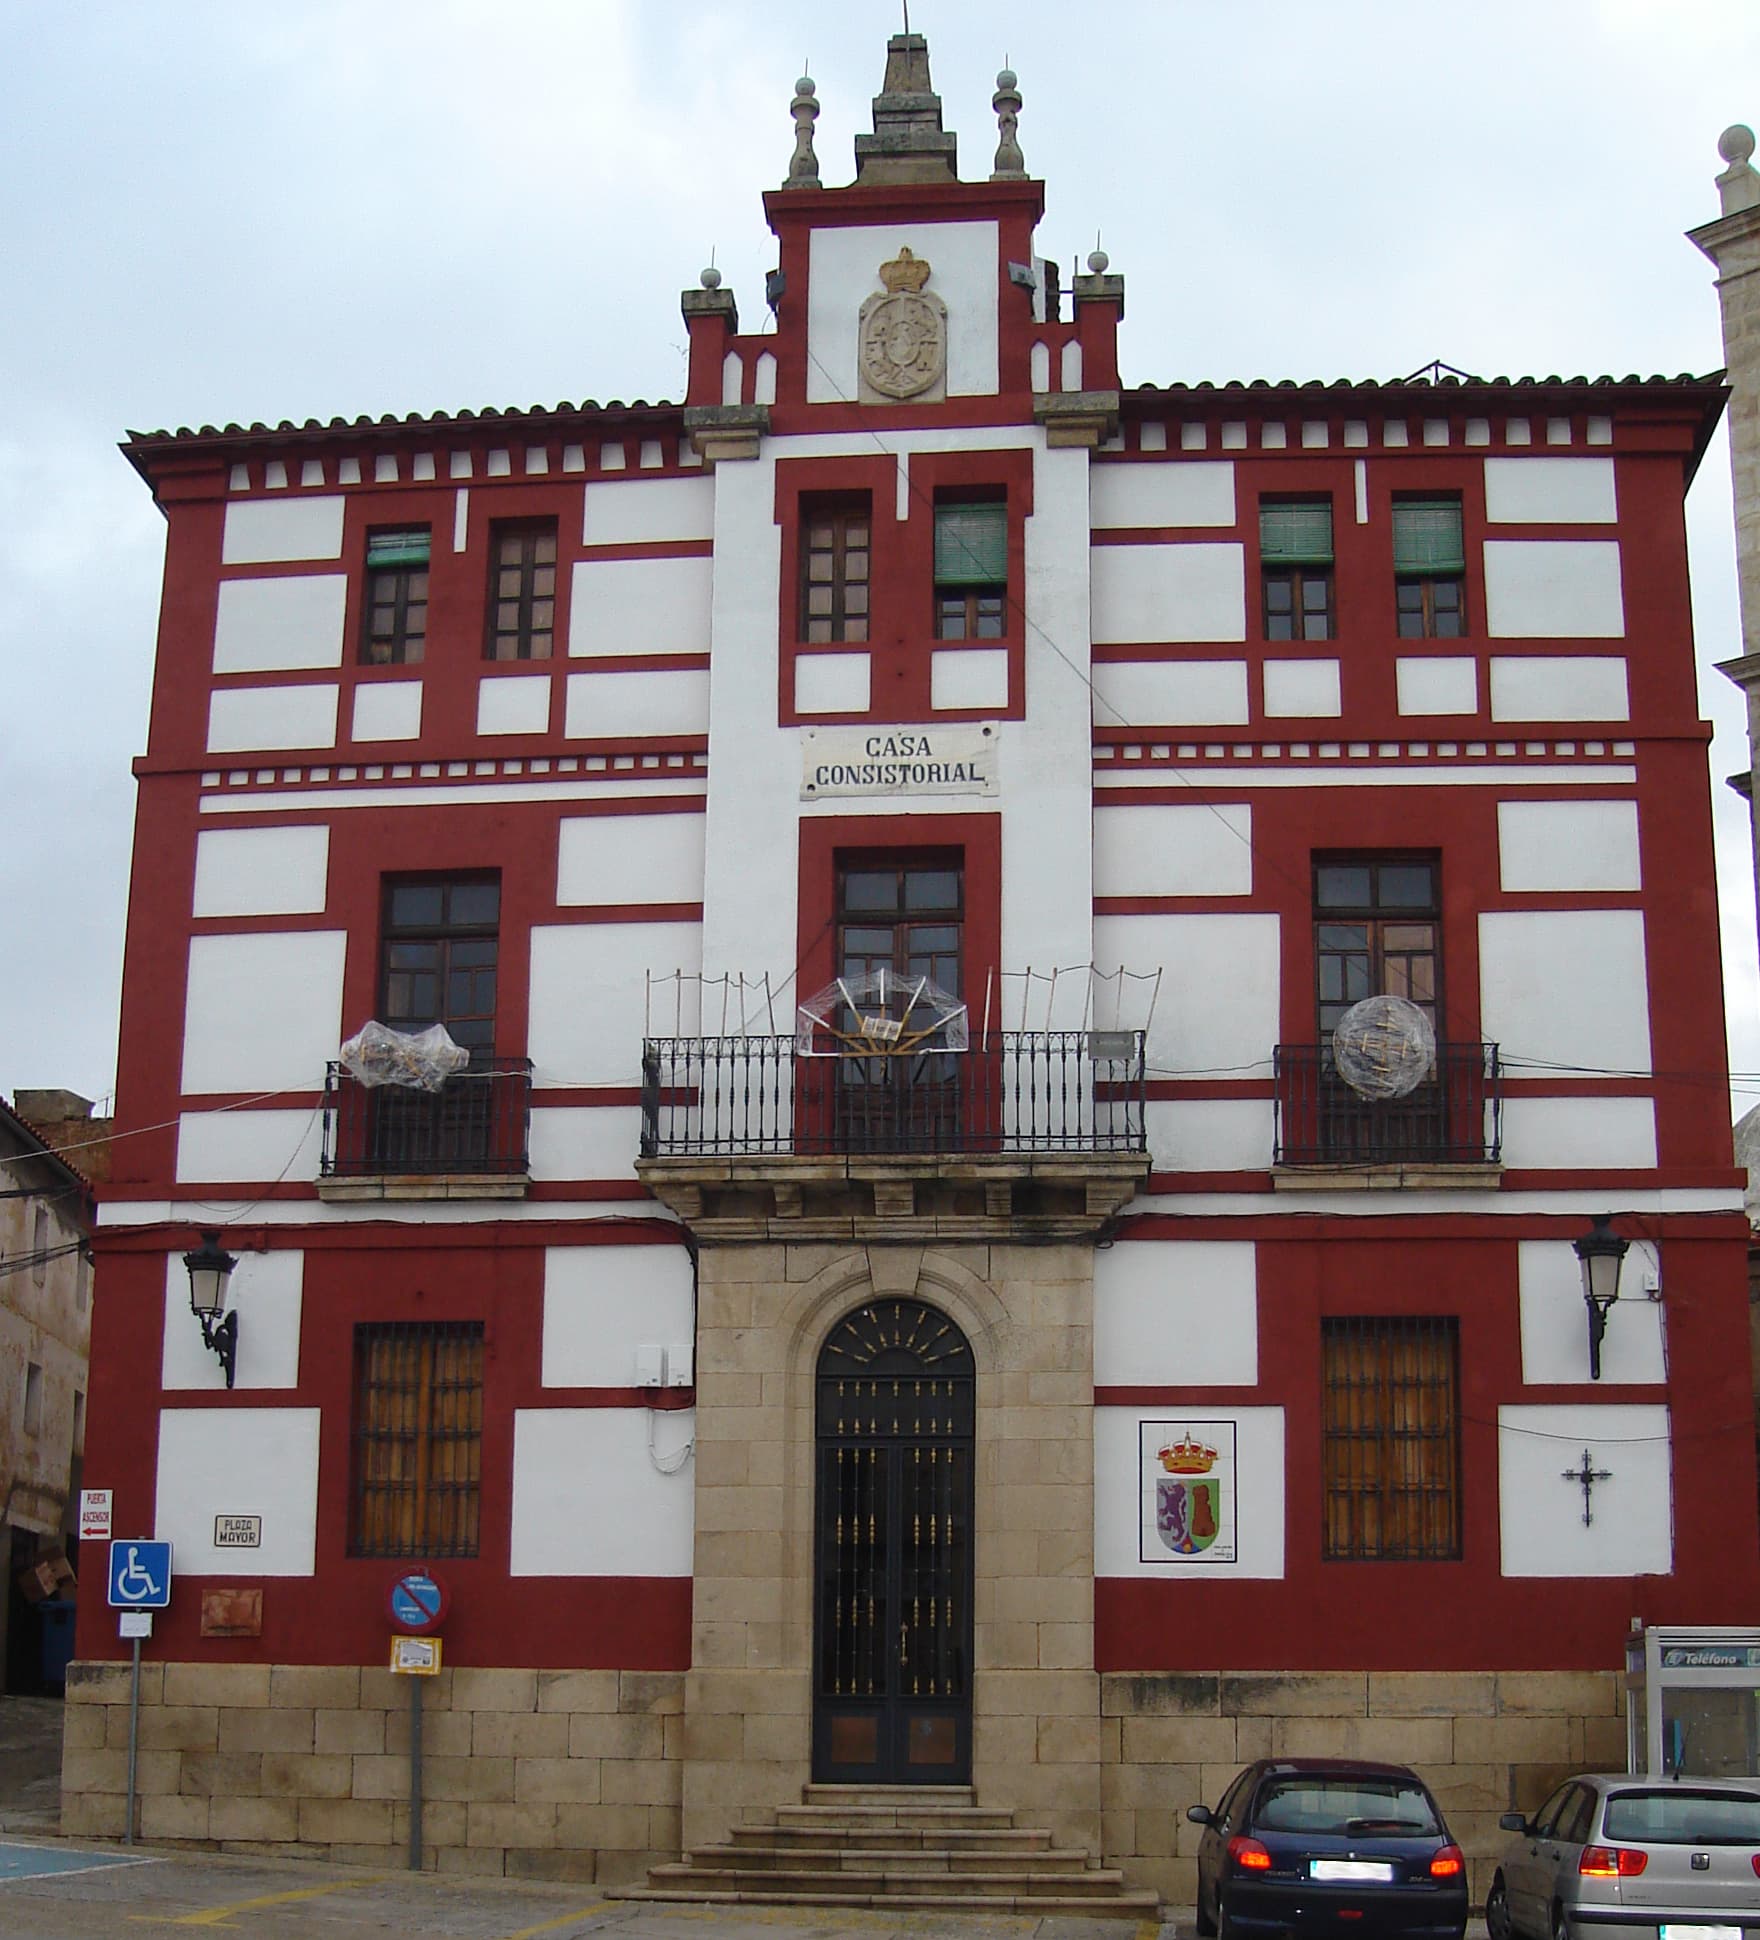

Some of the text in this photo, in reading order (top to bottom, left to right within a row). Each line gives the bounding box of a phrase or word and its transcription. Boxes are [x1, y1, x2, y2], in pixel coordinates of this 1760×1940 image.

[866, 737, 932, 757] CASA
[816, 763, 985, 785] CONSISTORIAL
[82, 1511, 110, 1523] ASCENSOR
[225, 1519, 252, 1530] PLAZA
[219, 1531, 257, 1544] MAYOR
